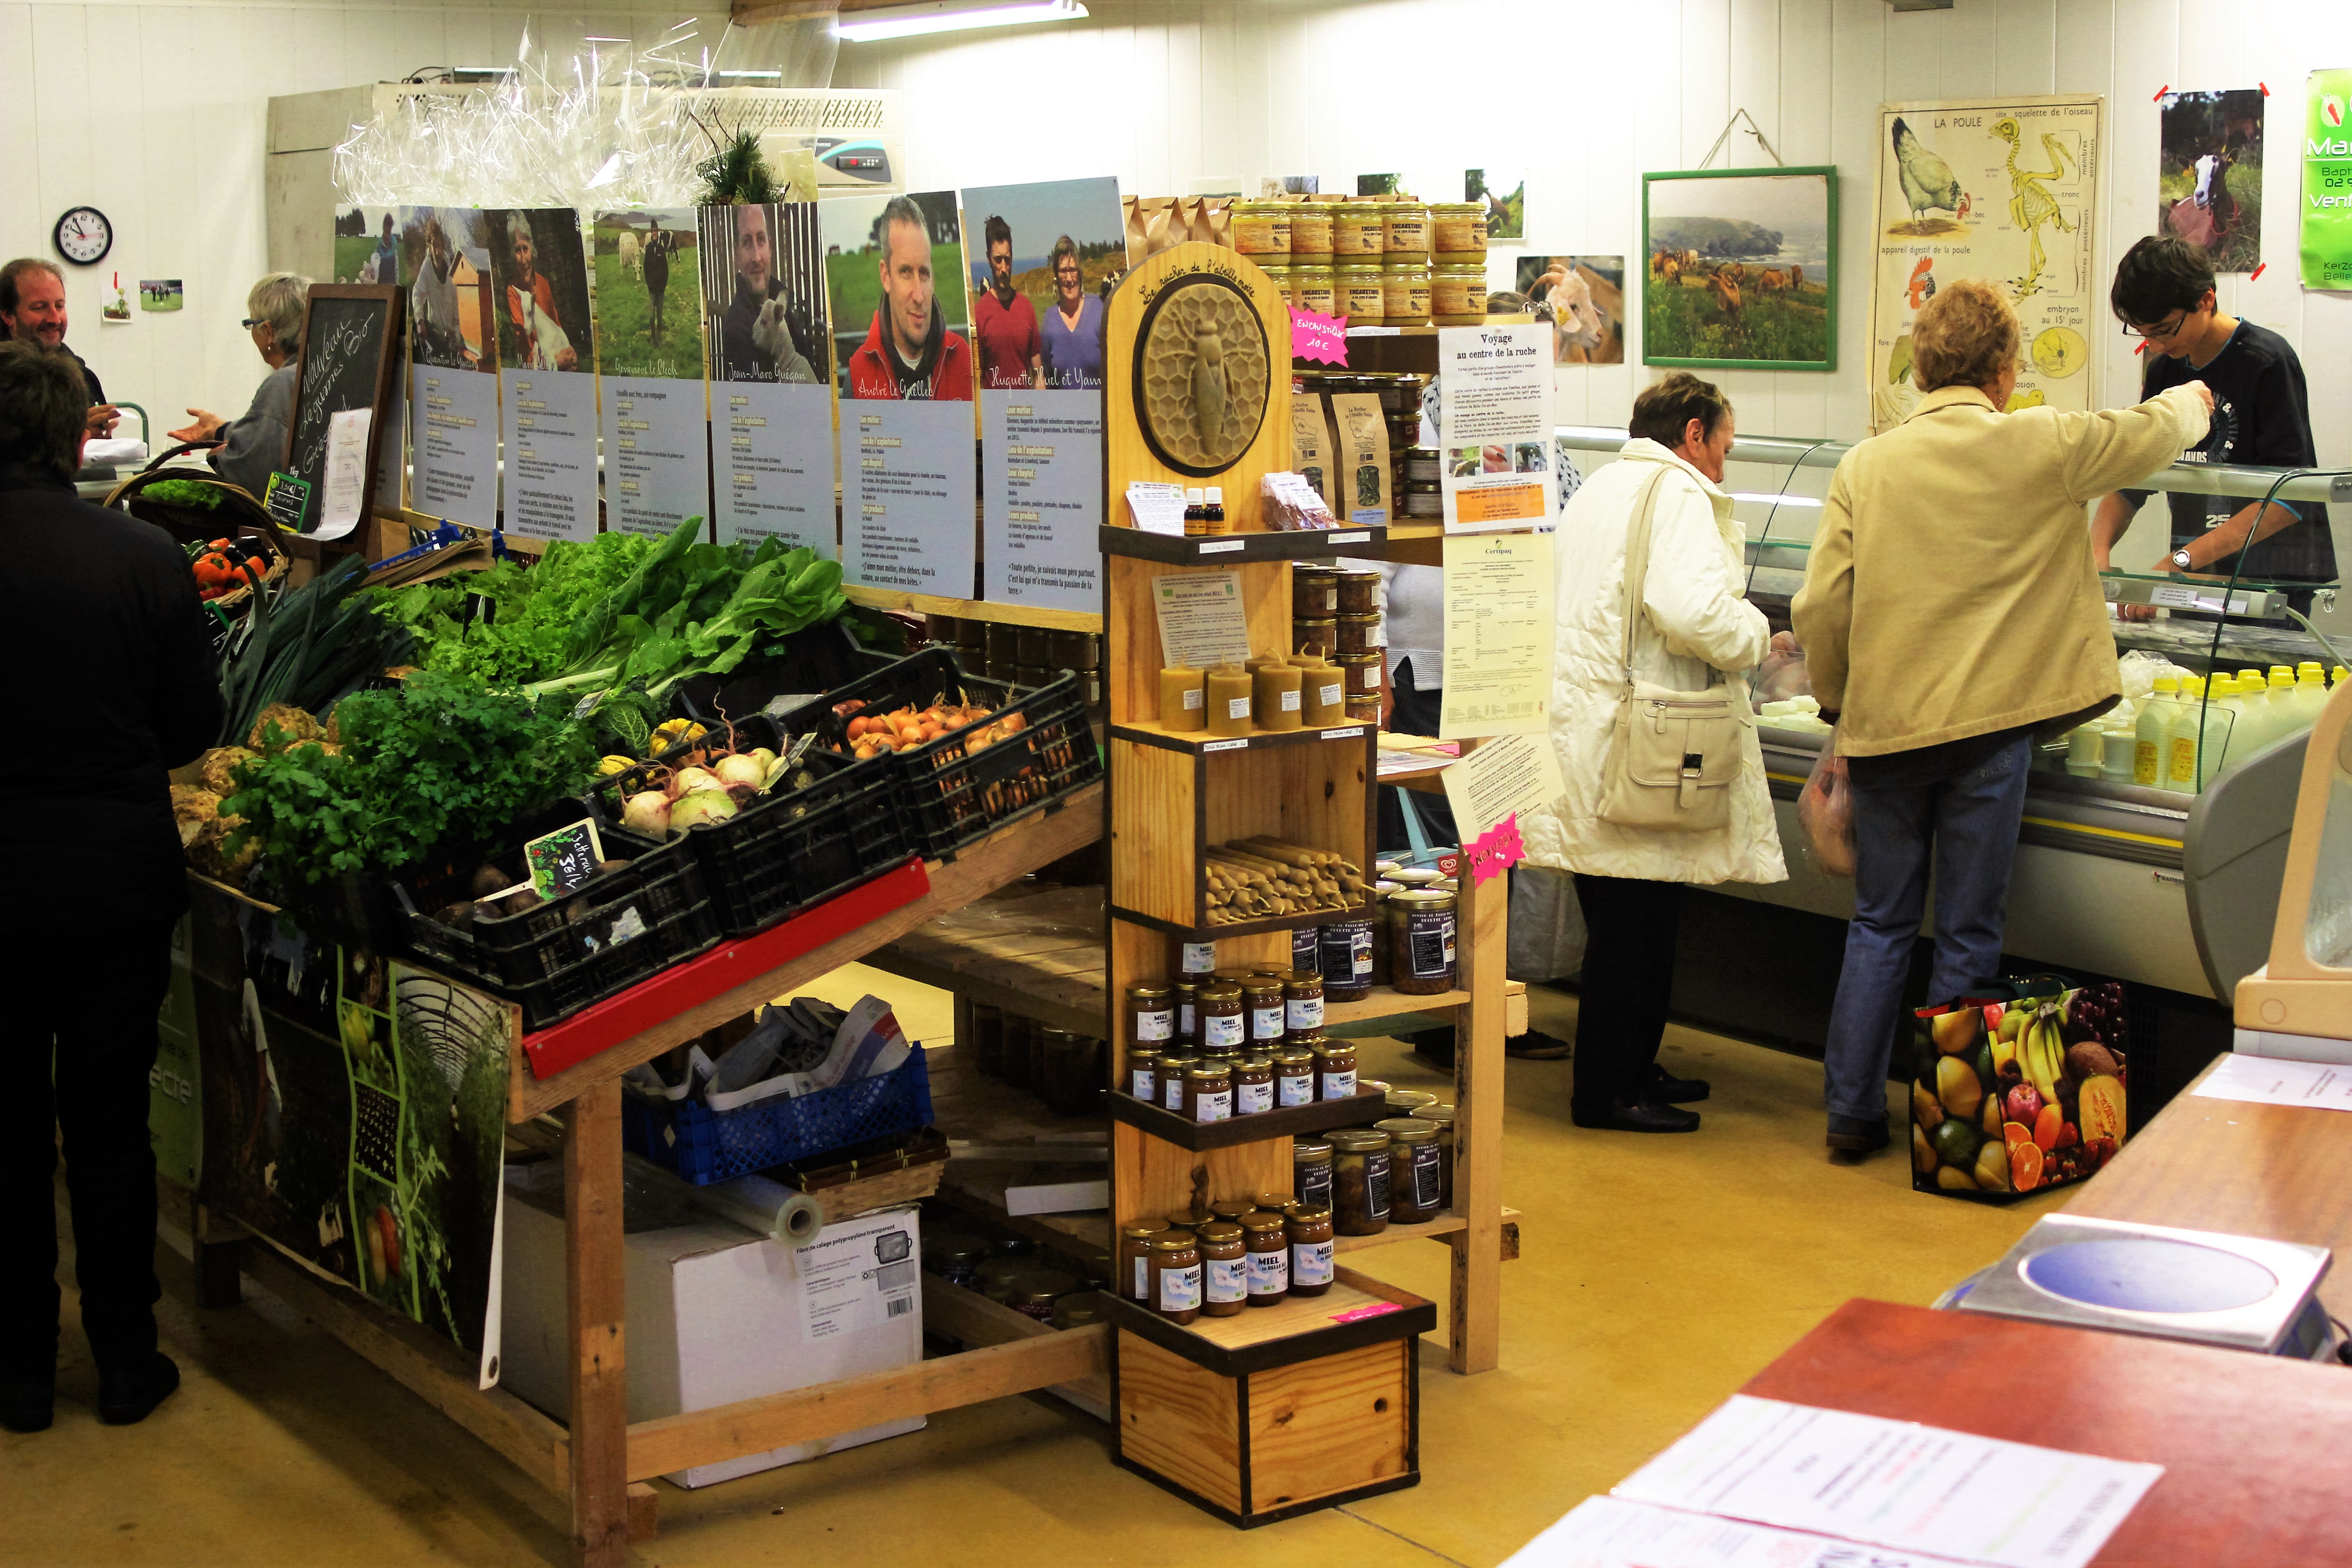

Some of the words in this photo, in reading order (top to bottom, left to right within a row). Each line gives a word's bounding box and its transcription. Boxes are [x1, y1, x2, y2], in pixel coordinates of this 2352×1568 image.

[2015, 109, 2047, 118] squelette
[2064, 107, 2093, 116] l'oiseau
[1935, 118, 1946, 128] LA
[1954, 117, 1982, 127] POULE
[2325, 178, 2343, 188] 02
[1881, 246, 1907, 254] appareil
[1910, 245, 1931, 254] digestif
[1952, 246, 1971, 254] poule
[1191, 262, 1200, 272] de
[2047, 305, 2079, 314] embryon
[2068, 316, 2083, 325] jour
[1307, 338, 1321, 347] 10
[1322, 342, 1328, 350] €
[1480, 334, 1512, 345] Voyage
[426, 347, 449, 365] Quentin
[1469, 350, 1493, 358] centre
[1495, 349, 1504, 357] de
[1507, 348, 1514, 356] la
[1516, 347, 1537, 356] ruche
[615, 357, 648, 377] Geneviève
[728, 361, 773, 381] Jean-Marc
[774, 362, 806, 387] Guégan
[859, 378, 888, 397] André
[990, 367, 1032, 398] Huguette
[1062, 371, 1072, 386] et
[2177, 451, 2207, 463] ANDS
[290, 466, 299, 477] 1kg
[884, 564, 898, 573] métier,
[907, 566, 921, 576] dehors,
[931, 568, 935, 576] la
[1011, 563, 1022, 571] Toute
[1023, 564, 1036, 574] petite,
[1037, 565, 1042, 575] je
[1042, 566, 1057, 574] suivais
[1067, 568, 1077, 577] père
[1078, 570, 1096, 578] partout.
[1008, 574, 1018, 583] C'est
[1032, 576, 1040, 585] m'a
[1041, 578, 1058, 587] transmis
[1059, 578, 1063, 587] la
[1064, 580, 1080, 589] passion
[1081, 581, 1087, 589] de
[1087, 581, 1092, 589] la
[1008, 587, 1019, 595] terre.
[1475, 831, 1515, 867] NOUVEAU
[816, 1241, 832, 1249] calage
[832, 1232, 866, 1246] polypropylène
[867, 1224, 895, 1236] transparent
[1316, 1246, 1332, 1256] MIEL
[1258, 1256, 1279, 1266] MIEL
[1231, 1262, 1246, 1273] MIEL
[1184, 1270, 1200, 1280] MIEL
